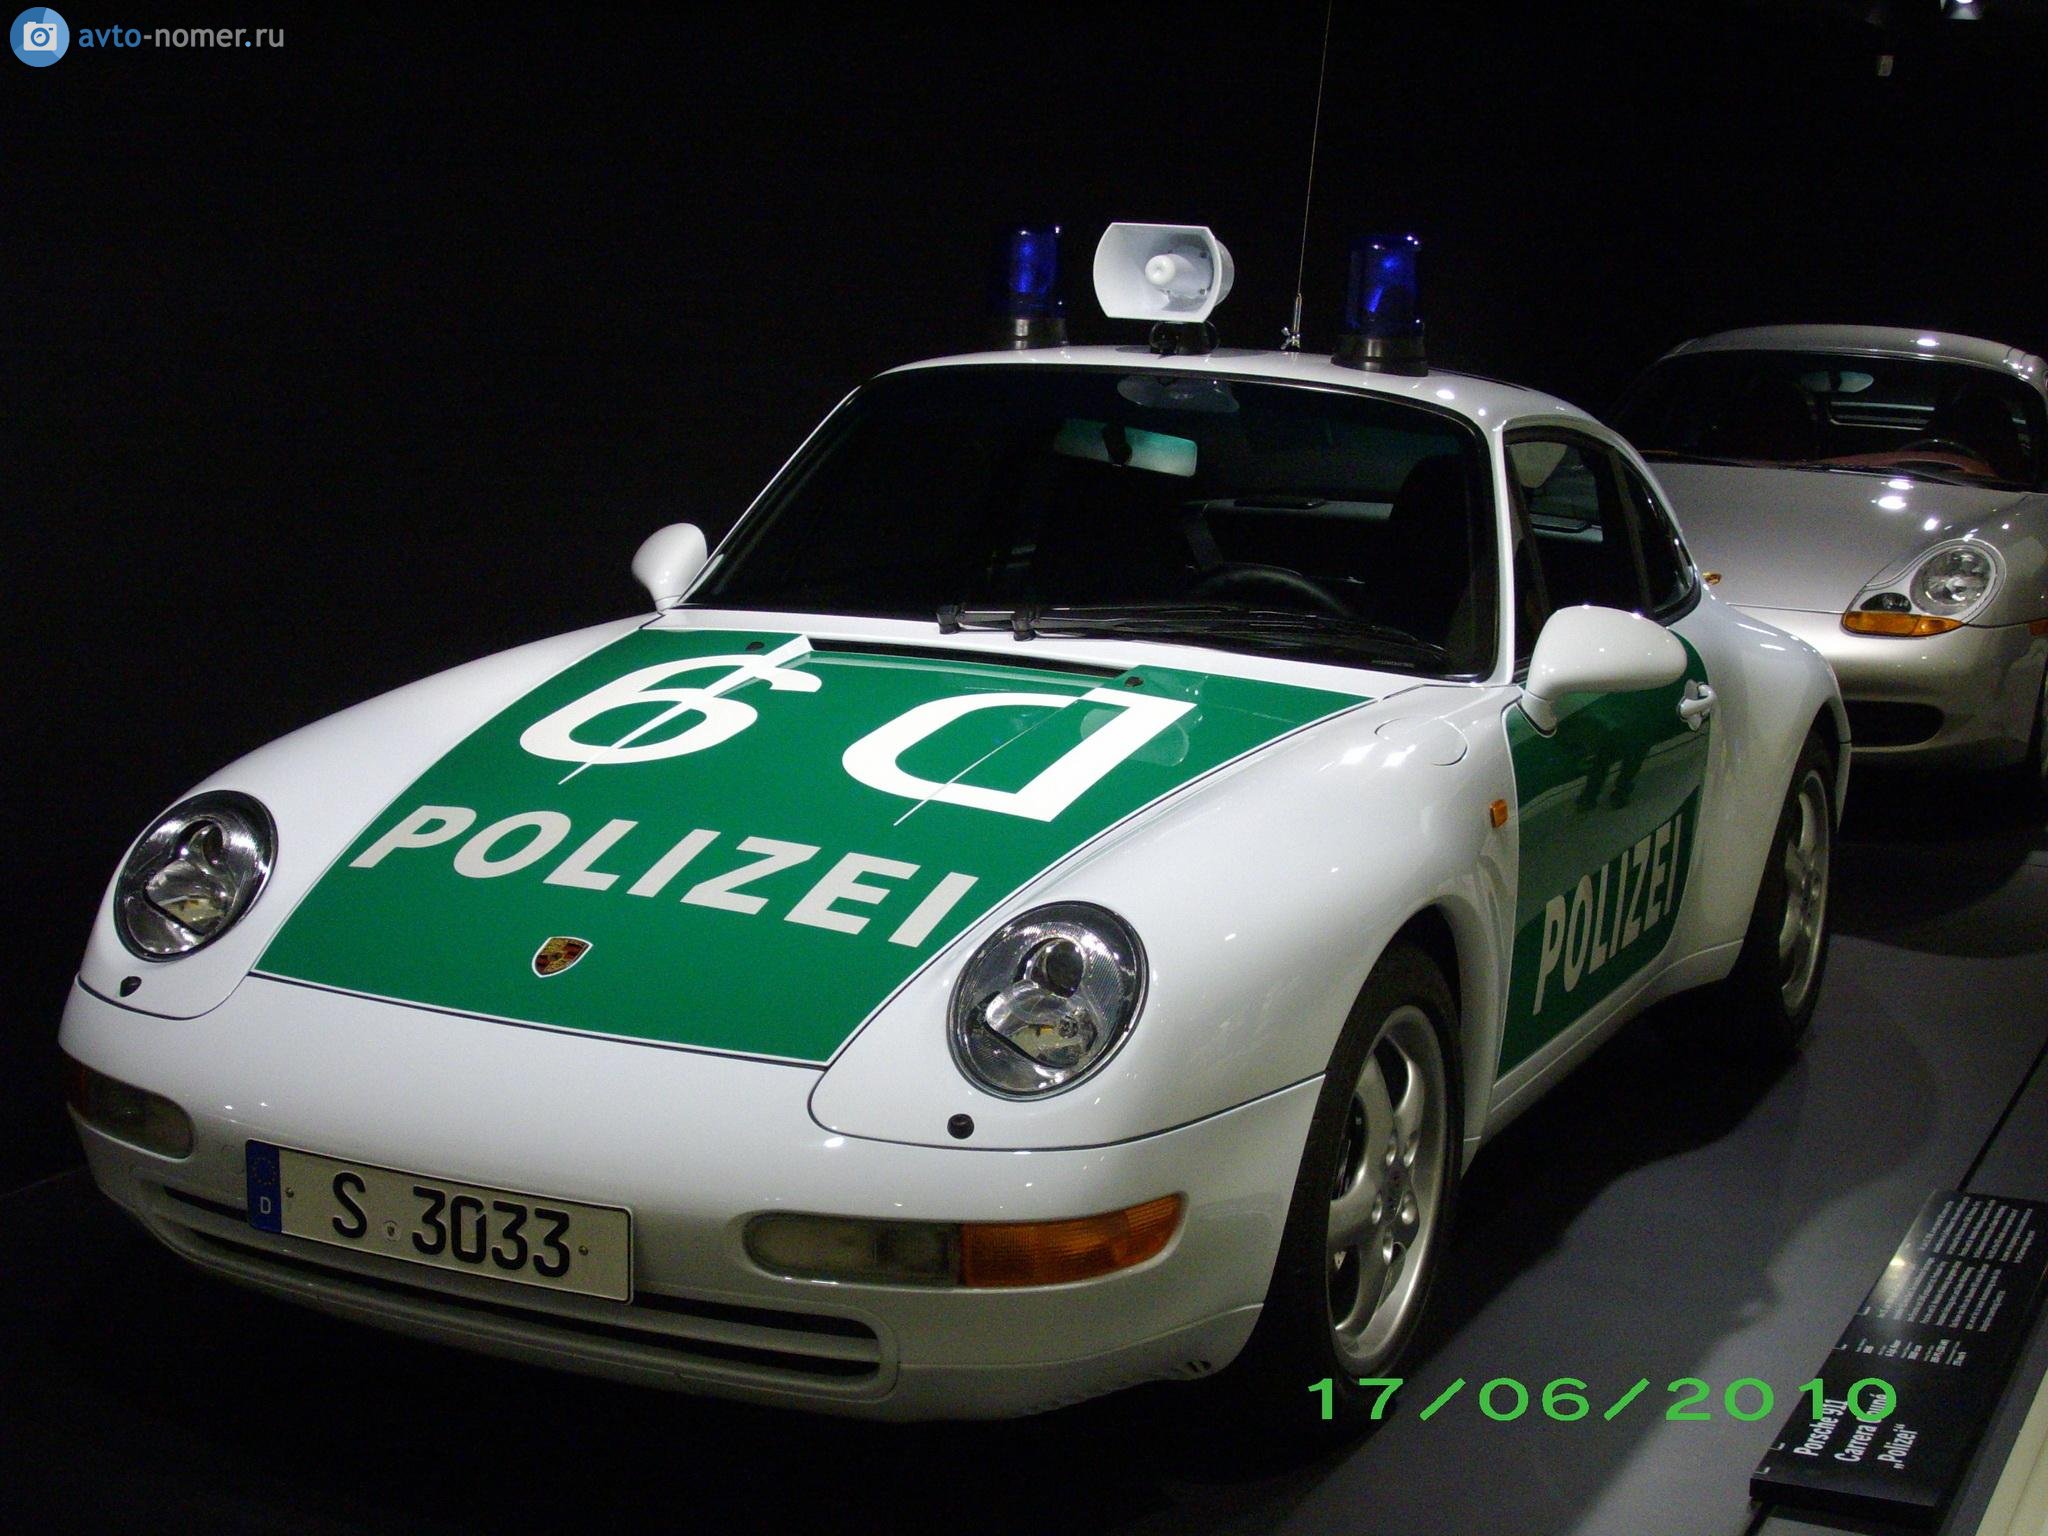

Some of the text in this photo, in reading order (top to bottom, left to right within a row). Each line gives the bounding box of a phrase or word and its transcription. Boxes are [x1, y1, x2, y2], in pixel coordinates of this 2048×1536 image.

[349, 805, 980, 948] POLIZEI
[1532, 813, 1682, 1016] POLIZEI
[259, 1196, 272, 1215] D
[332, 1171, 571, 1278] S 3033
[1793, 1398, 1849, 1457] Porsche 911
[1833, 1424, 1878, 1462] Carrera
